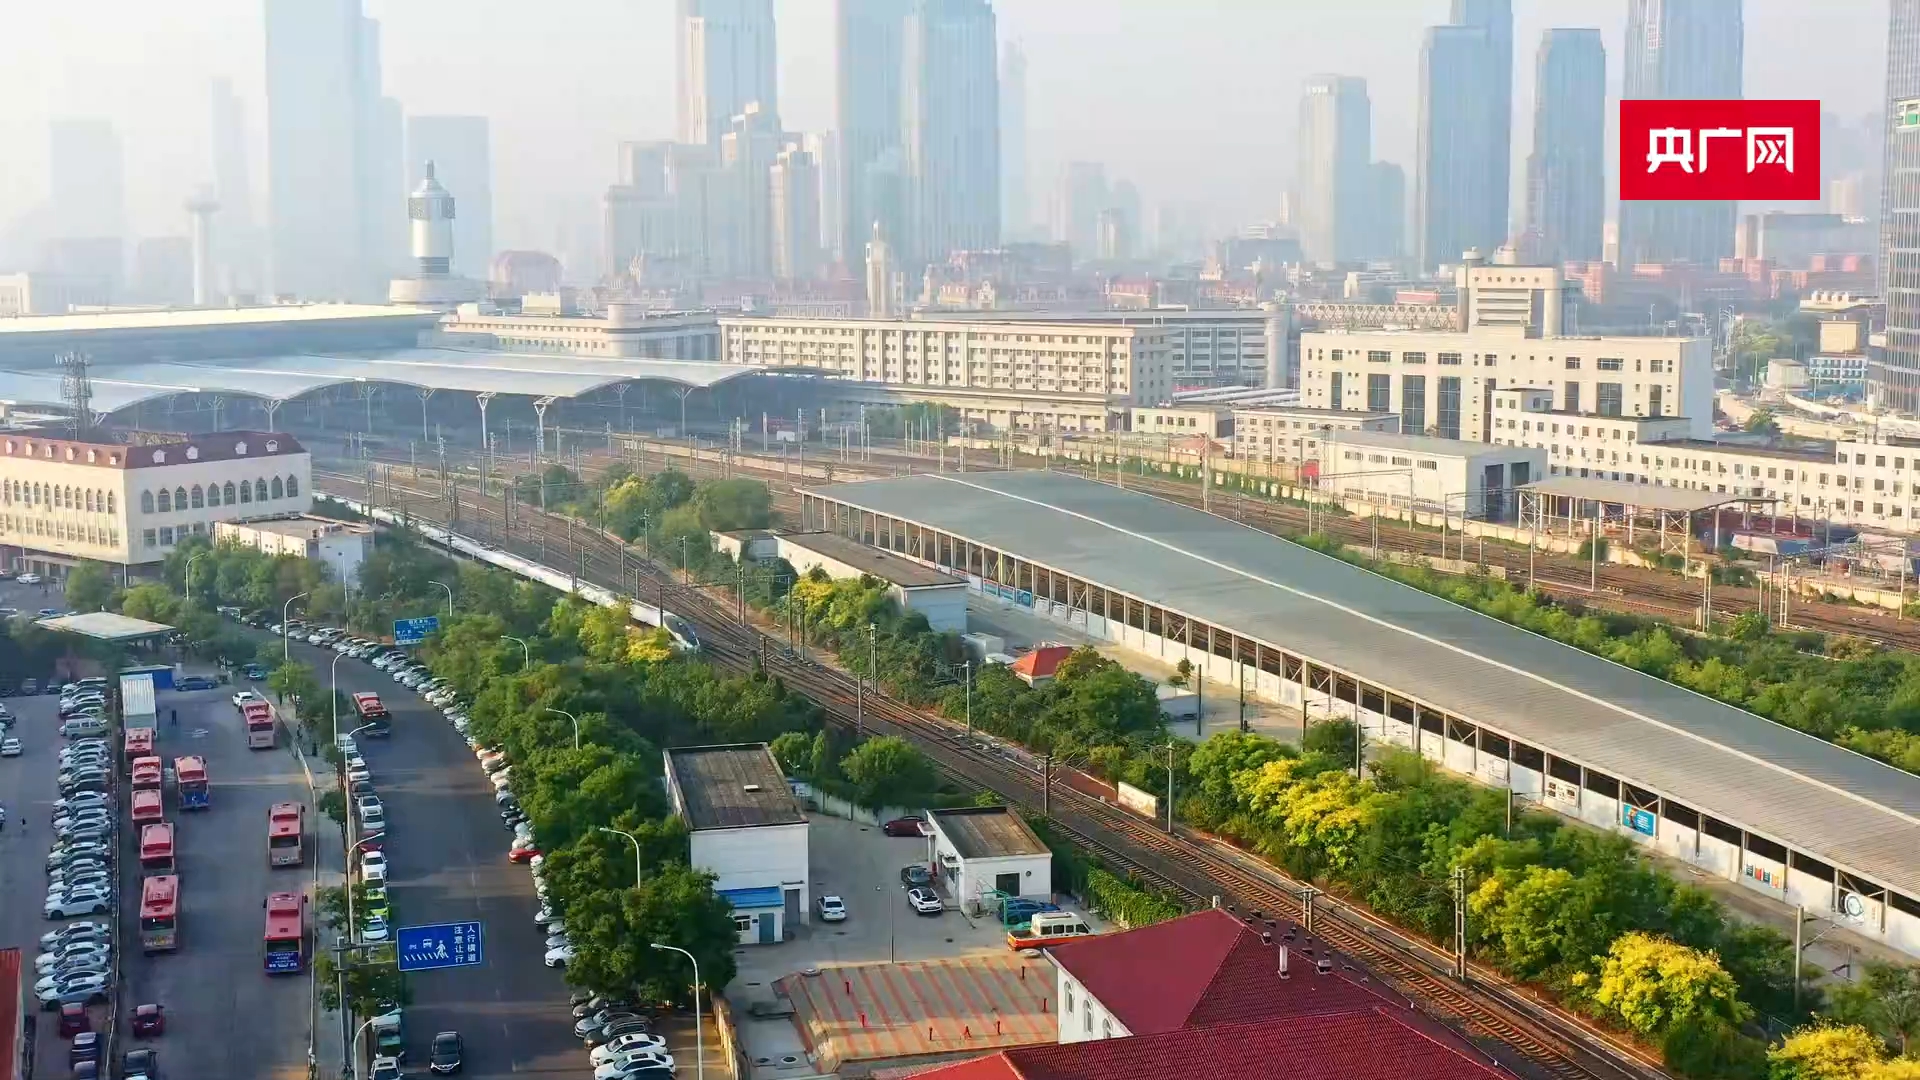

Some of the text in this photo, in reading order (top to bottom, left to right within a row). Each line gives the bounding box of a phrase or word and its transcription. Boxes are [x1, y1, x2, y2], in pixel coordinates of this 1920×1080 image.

[454, 926, 464, 963] 注意让行
[467, 925, 476, 962] 人行横道
